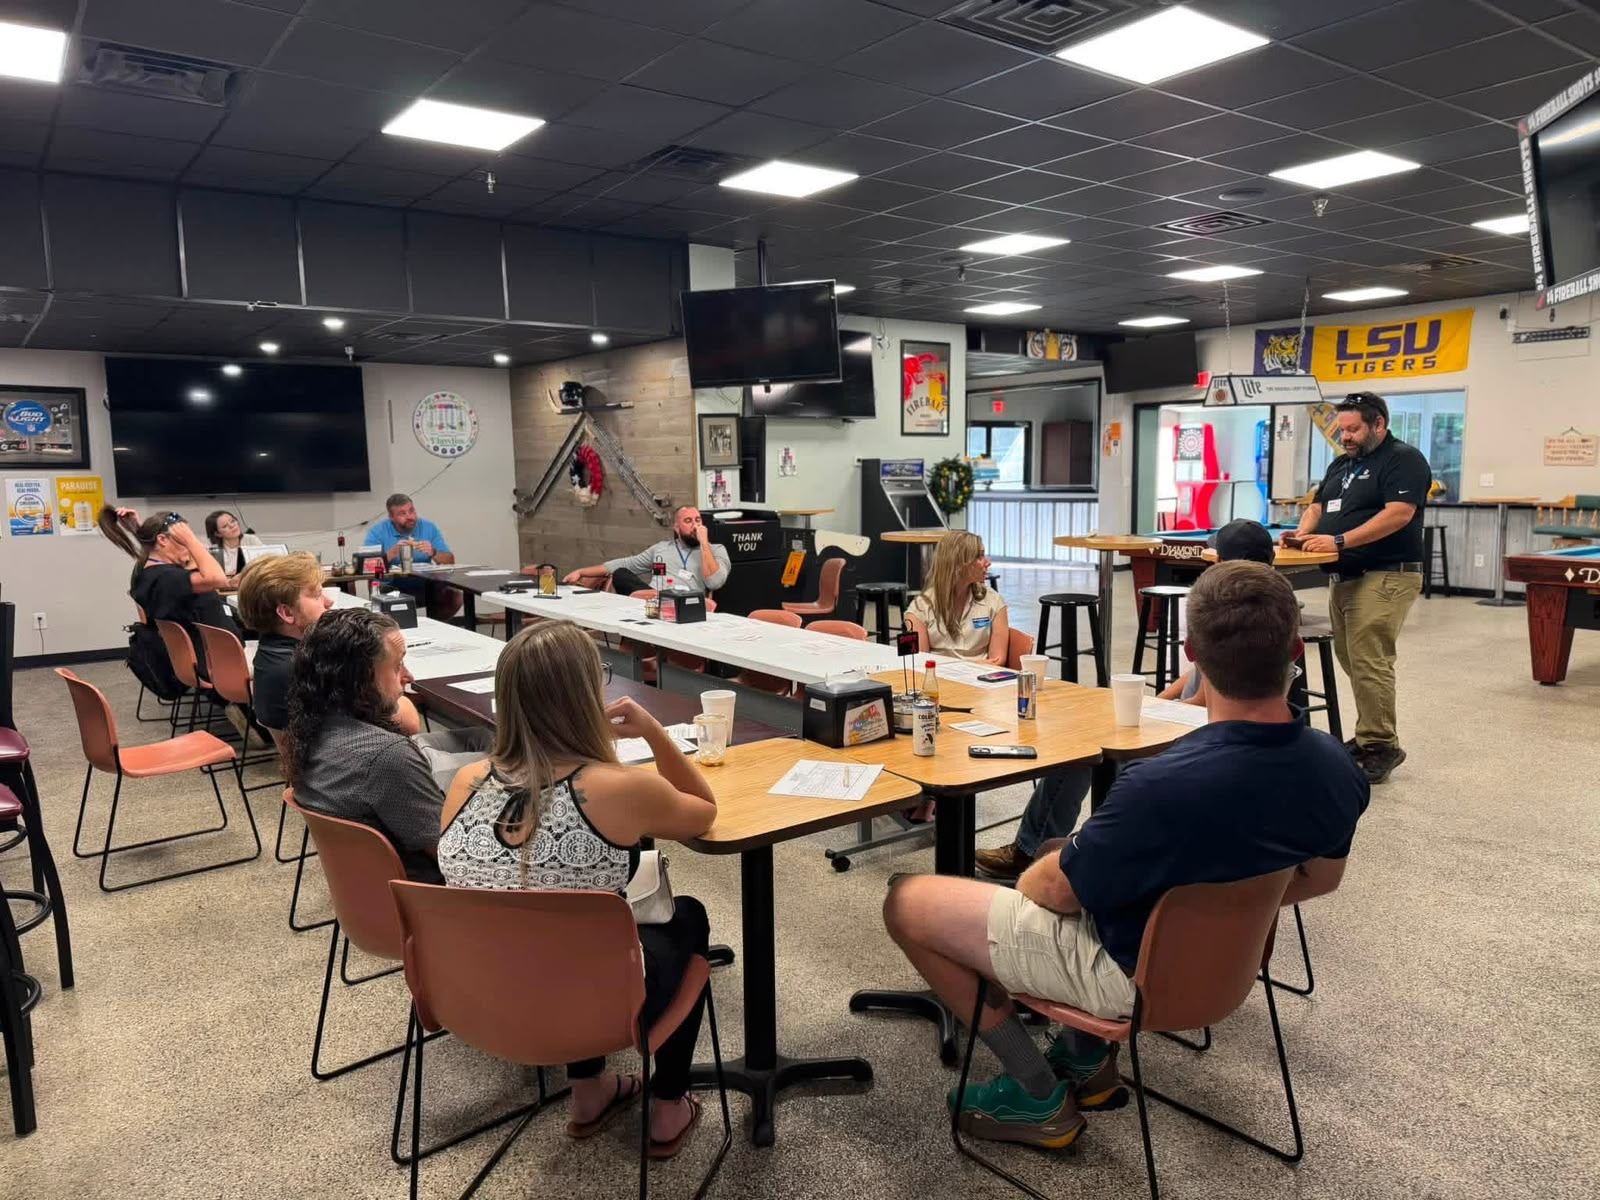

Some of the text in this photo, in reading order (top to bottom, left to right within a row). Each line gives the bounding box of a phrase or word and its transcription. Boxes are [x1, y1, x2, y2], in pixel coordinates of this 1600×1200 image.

[1535, 90, 1568, 127] FIREBALL
[1568, 72, 1594, 104] SHOTS
[1526, 193, 1542, 274] FIREBALL
[1554, 278, 1588, 304] FIREBALL
[1336, 320, 1441, 362] LSU
[1336, 355, 1436, 375] TIGERS
[1240, 378, 1262, 398] Lite
[906, 396, 945, 416] FIREBALL
[61, 481, 96, 490] PARADISE
[732, 532, 762, 543] THANK
[738, 542, 757, 552] YOU
[1156, 544, 1204, 559] DIAMOND
